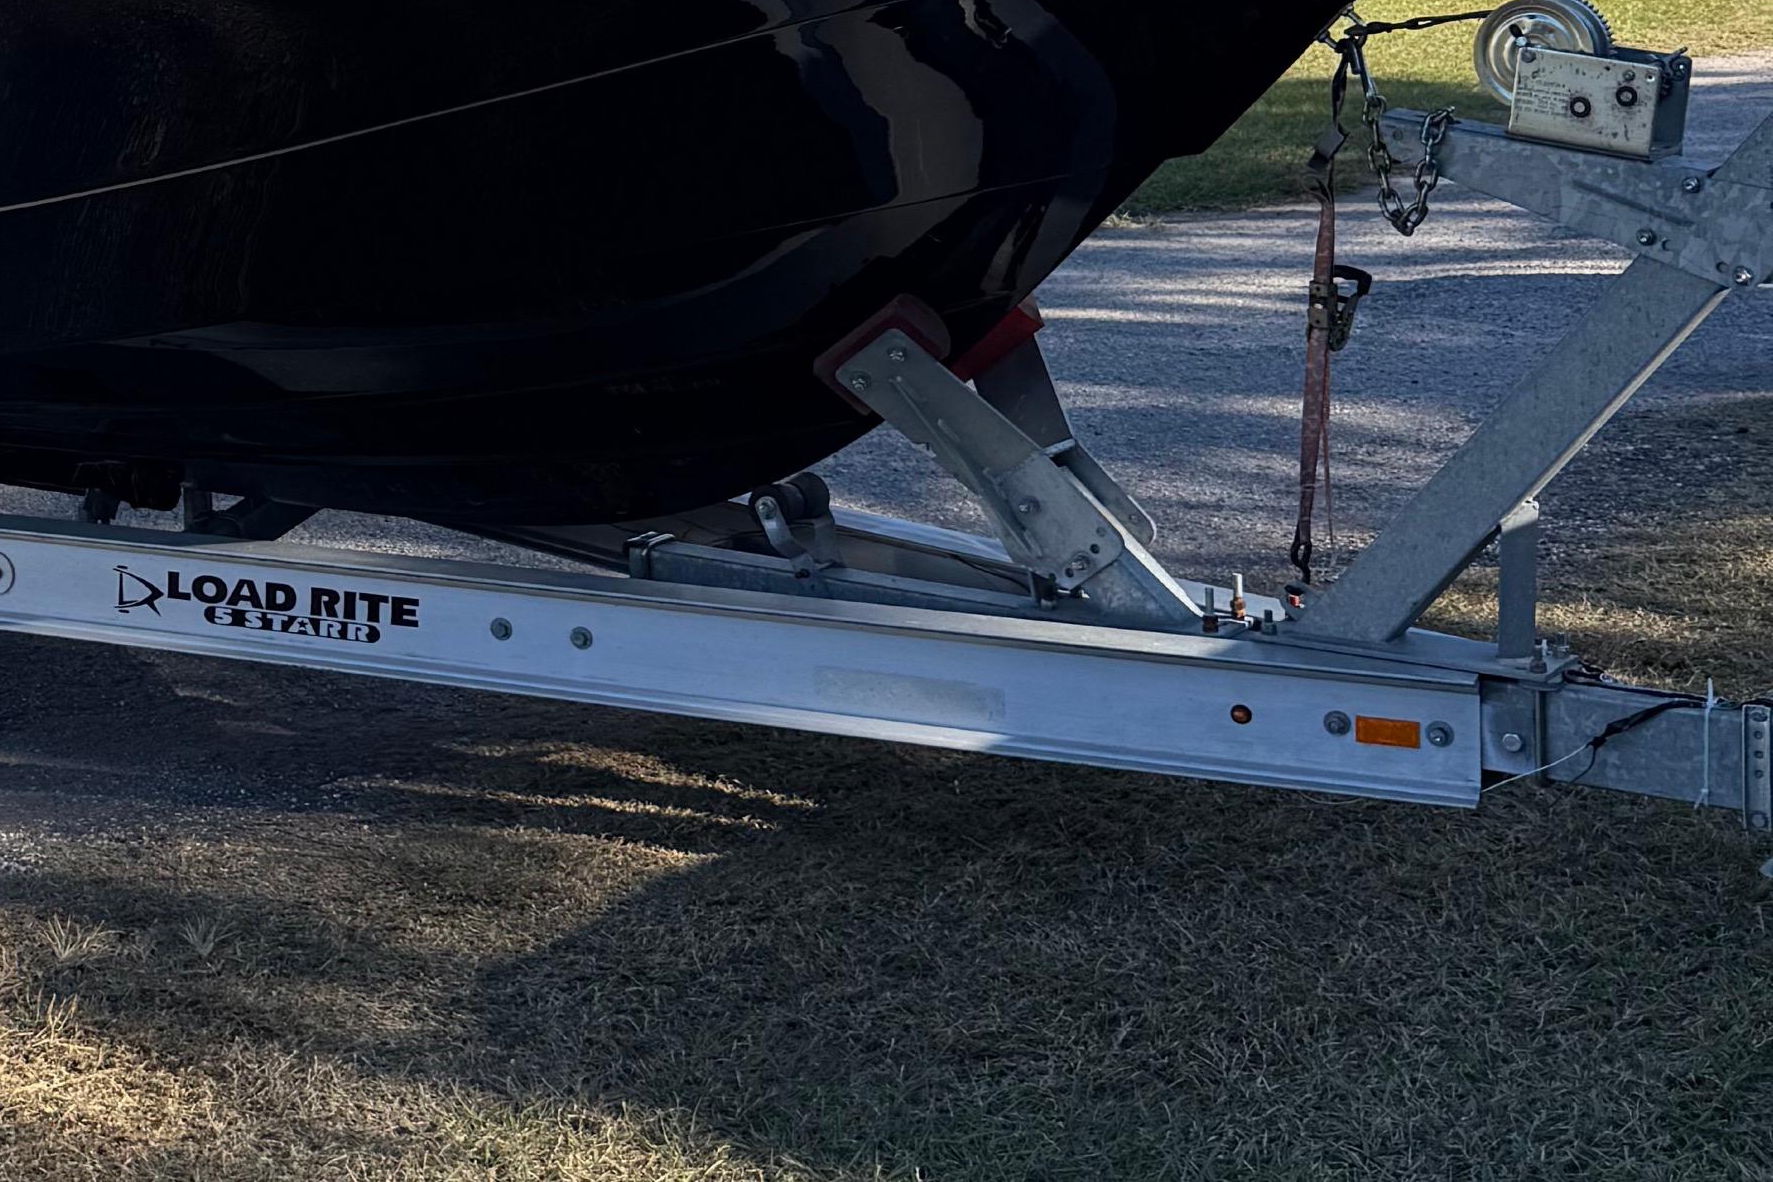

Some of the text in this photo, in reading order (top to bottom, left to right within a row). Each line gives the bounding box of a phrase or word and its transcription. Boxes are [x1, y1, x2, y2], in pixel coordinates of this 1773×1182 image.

[167, 570, 420, 628] LOAD RITE
[213, 607, 371, 642] 5 STARR
